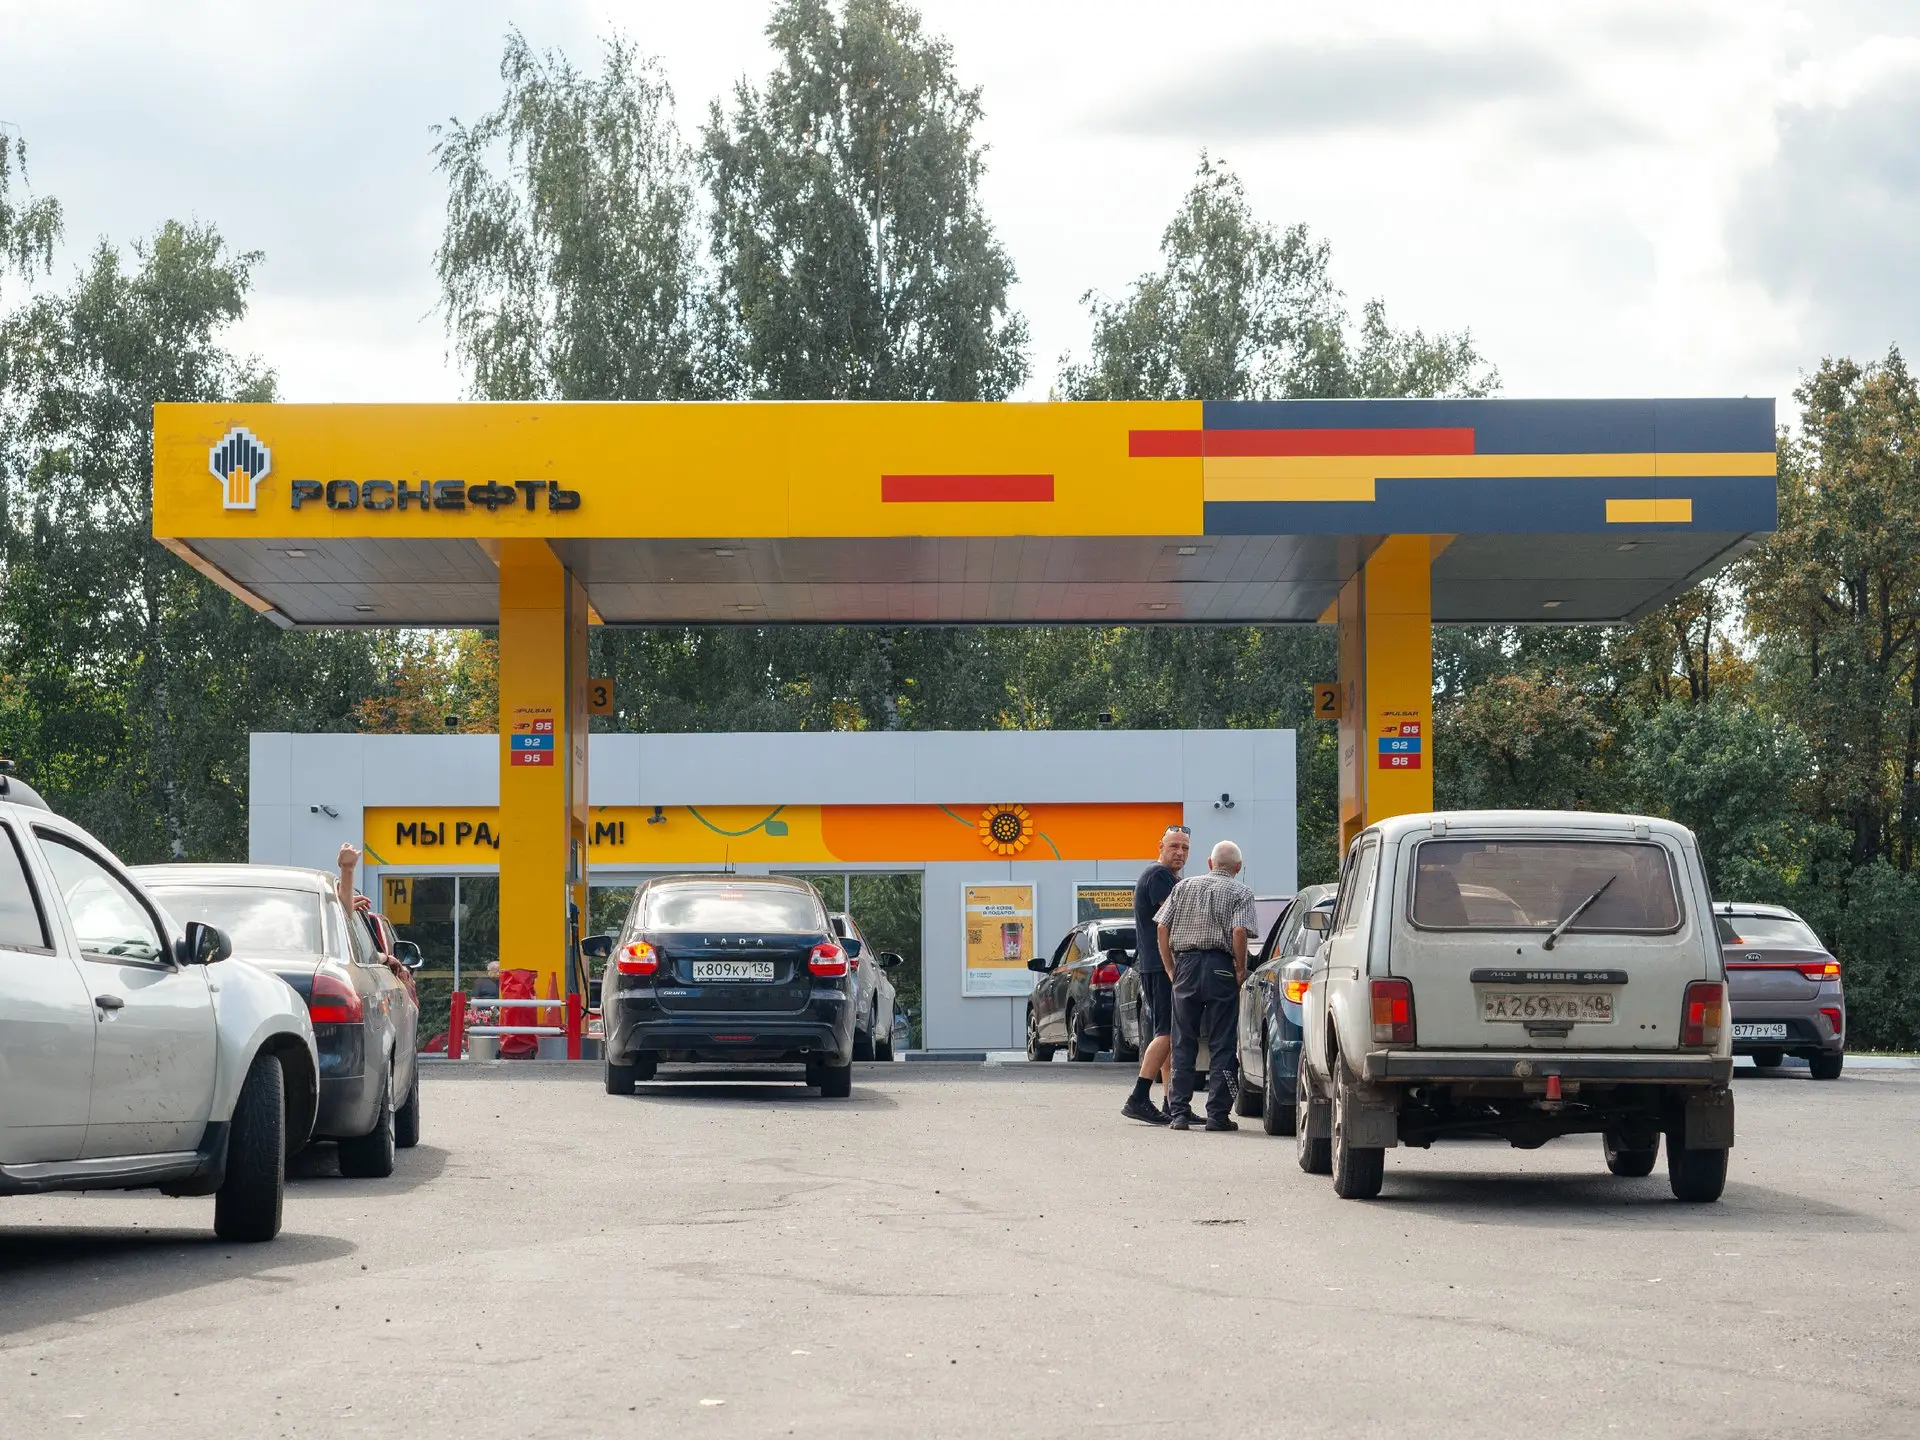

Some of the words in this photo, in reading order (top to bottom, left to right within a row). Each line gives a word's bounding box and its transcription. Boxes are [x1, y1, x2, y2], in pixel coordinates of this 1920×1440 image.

[291, 480, 581, 511] РОСНЕФТЬ
[593, 686, 608, 707] 3
[1321, 691, 1336, 711] 2
[535, 722, 552, 731] 95
[1402, 725, 1419, 734] 95
[524, 738, 541, 747] 92
[1391, 741, 1408, 750] 92
[524, 754, 541, 763] 95
[1391, 757, 1408, 766] 95
[396, 822, 444, 846] МЫ
[589, 821, 625, 846] М!
[704, 938, 764, 946] LADA
[697, 963, 749, 976] К809КУ
[751, 963, 771, 973] 136
[1526, 972, 1578, 980] НИВА
[1772, 1024, 1783, 1033] 48
